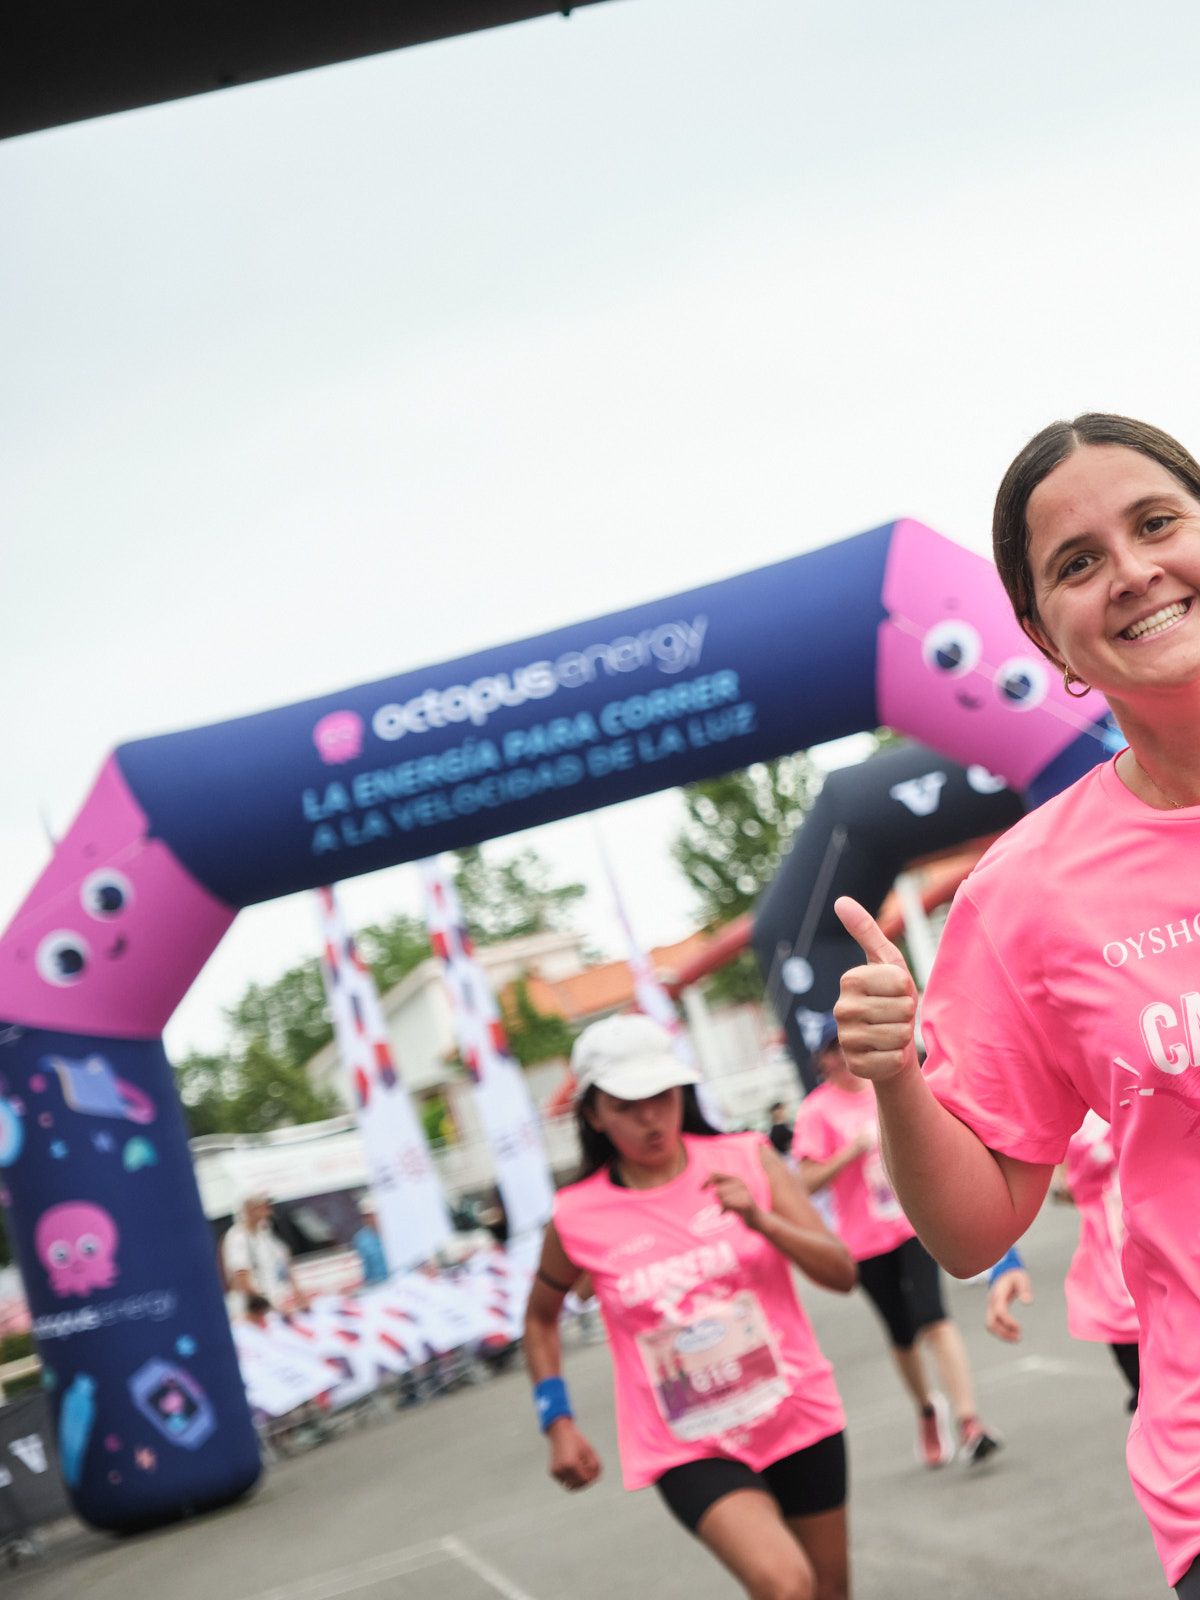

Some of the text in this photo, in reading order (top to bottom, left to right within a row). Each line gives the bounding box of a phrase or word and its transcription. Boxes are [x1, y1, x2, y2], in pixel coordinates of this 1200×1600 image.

[301, 669, 740, 822] LA ENERGÍA PARA CORRER
[342, 810, 391, 846] LA
[393, 754, 584, 832] VELOCIDAD
[586, 739, 634, 777] DE
[637, 725, 686, 763] LA
[688, 702, 757, 747] LUZ
